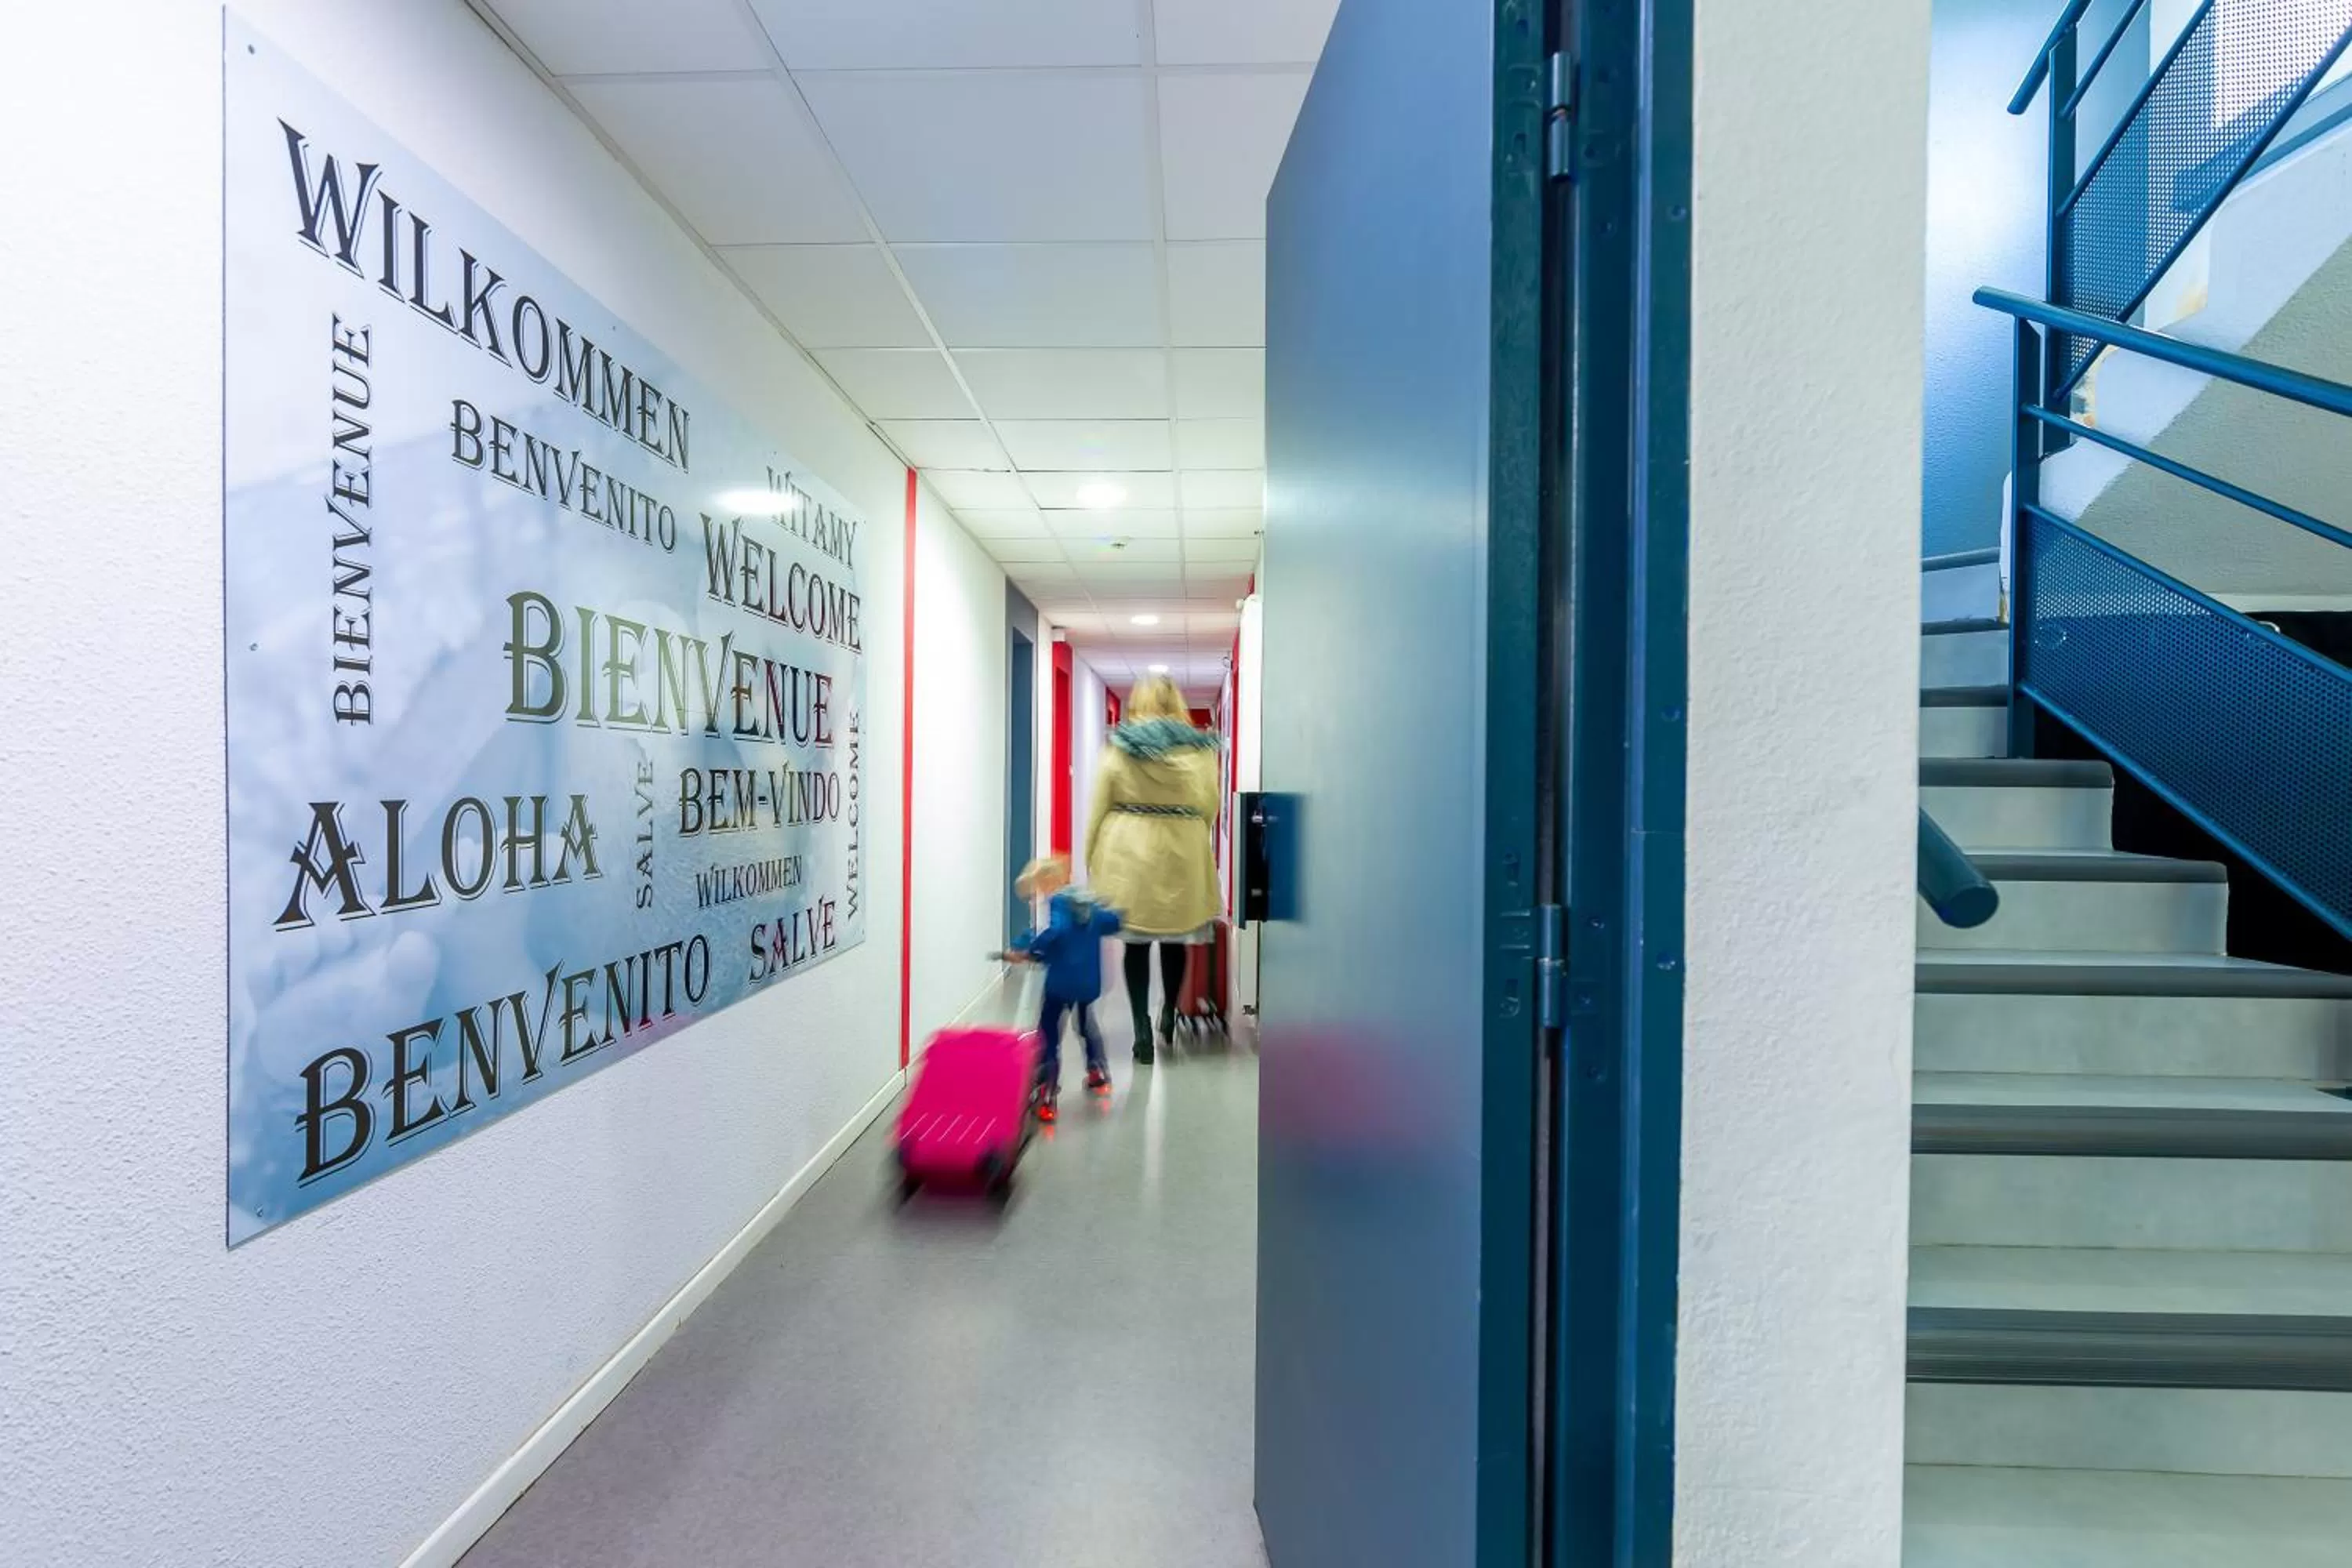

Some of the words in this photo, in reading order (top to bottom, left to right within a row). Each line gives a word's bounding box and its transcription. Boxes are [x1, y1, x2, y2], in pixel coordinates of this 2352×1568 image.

[277, 116, 690, 473] WILKOMMEN
[325, 311, 373, 725] BIENVENUE
[450, 399, 677, 554] BENVENITO
[699, 512, 862, 654] WELCOME
[503, 590, 833, 749] BIENVENUE
[274, 793, 603, 931] ALOHA
[633, 760, 653, 909] SALVE
[679, 760, 840, 837] BEM-VINDO
[846, 709, 860, 920] WELCOME
[695, 854, 803, 909] WILKOMMEN
[749, 894, 837, 985] SALVE
[295, 934, 711, 1188] BENVENITO
